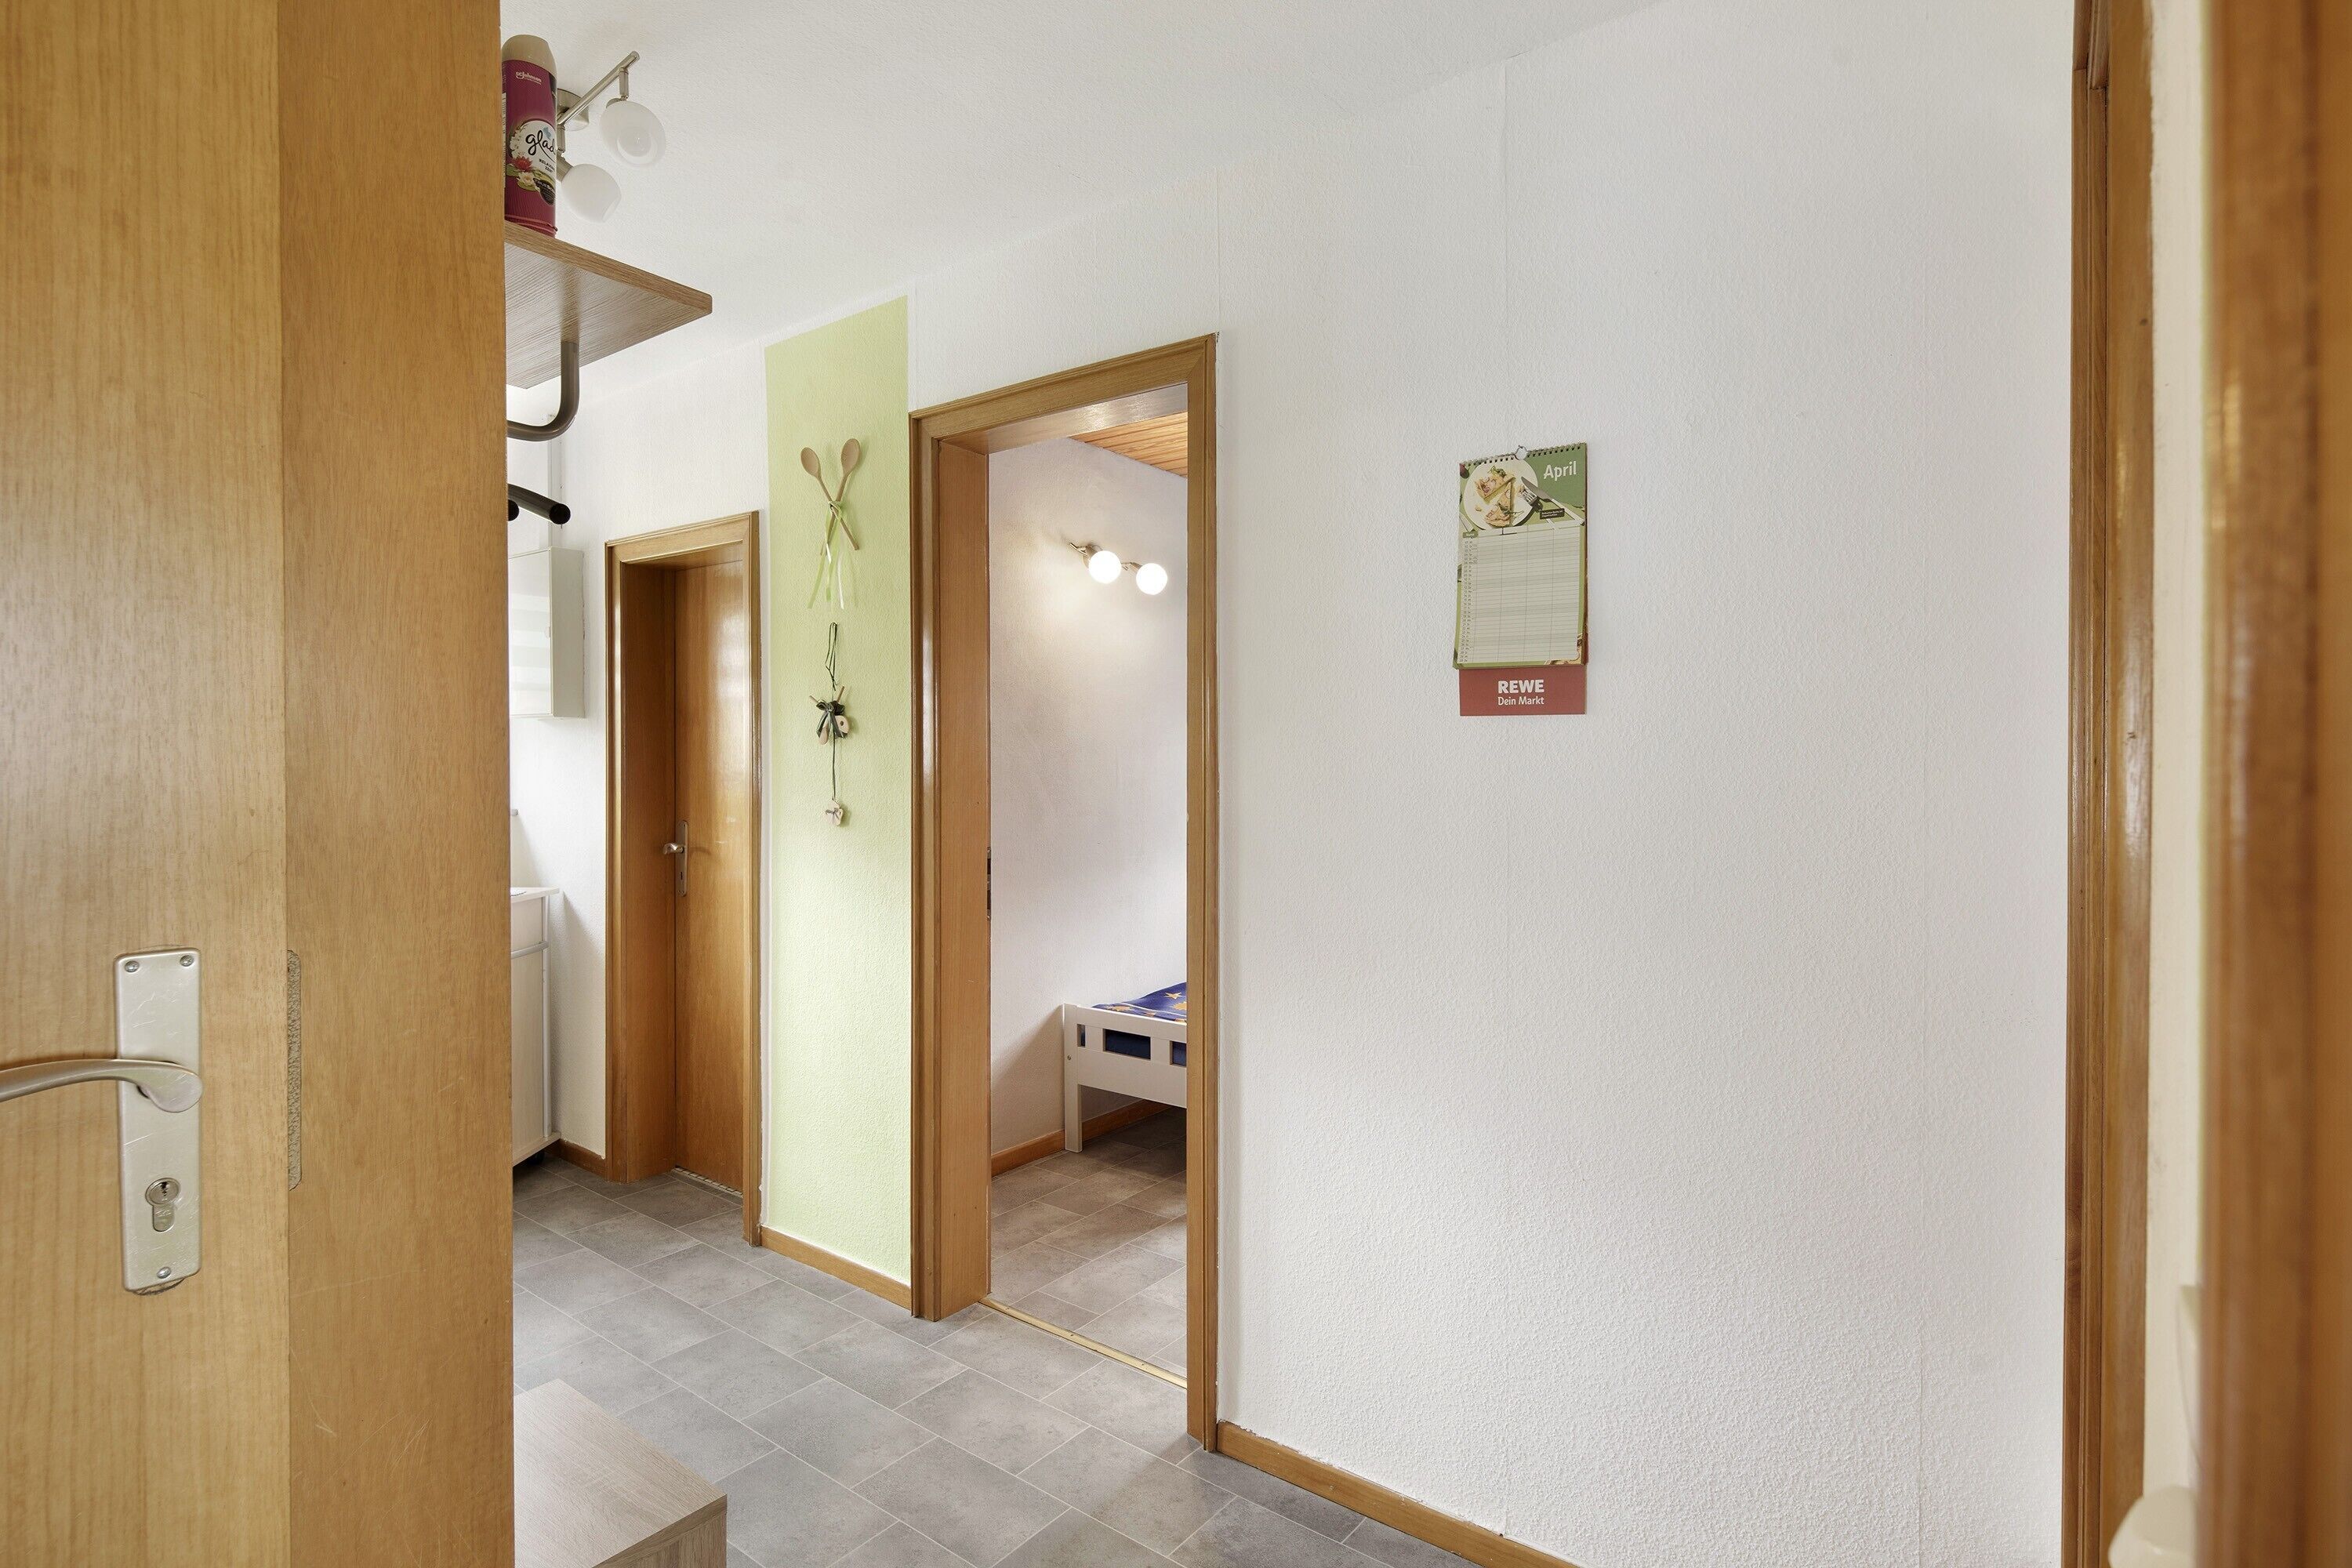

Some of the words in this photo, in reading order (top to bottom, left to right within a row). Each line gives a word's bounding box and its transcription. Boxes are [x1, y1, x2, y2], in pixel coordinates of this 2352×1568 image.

[1544, 461, 1577, 481] April
[1497, 679, 1544, 694] REWE
[1497, 696, 1516, 706] Dein
[1518, 696, 1544, 705] Markt
